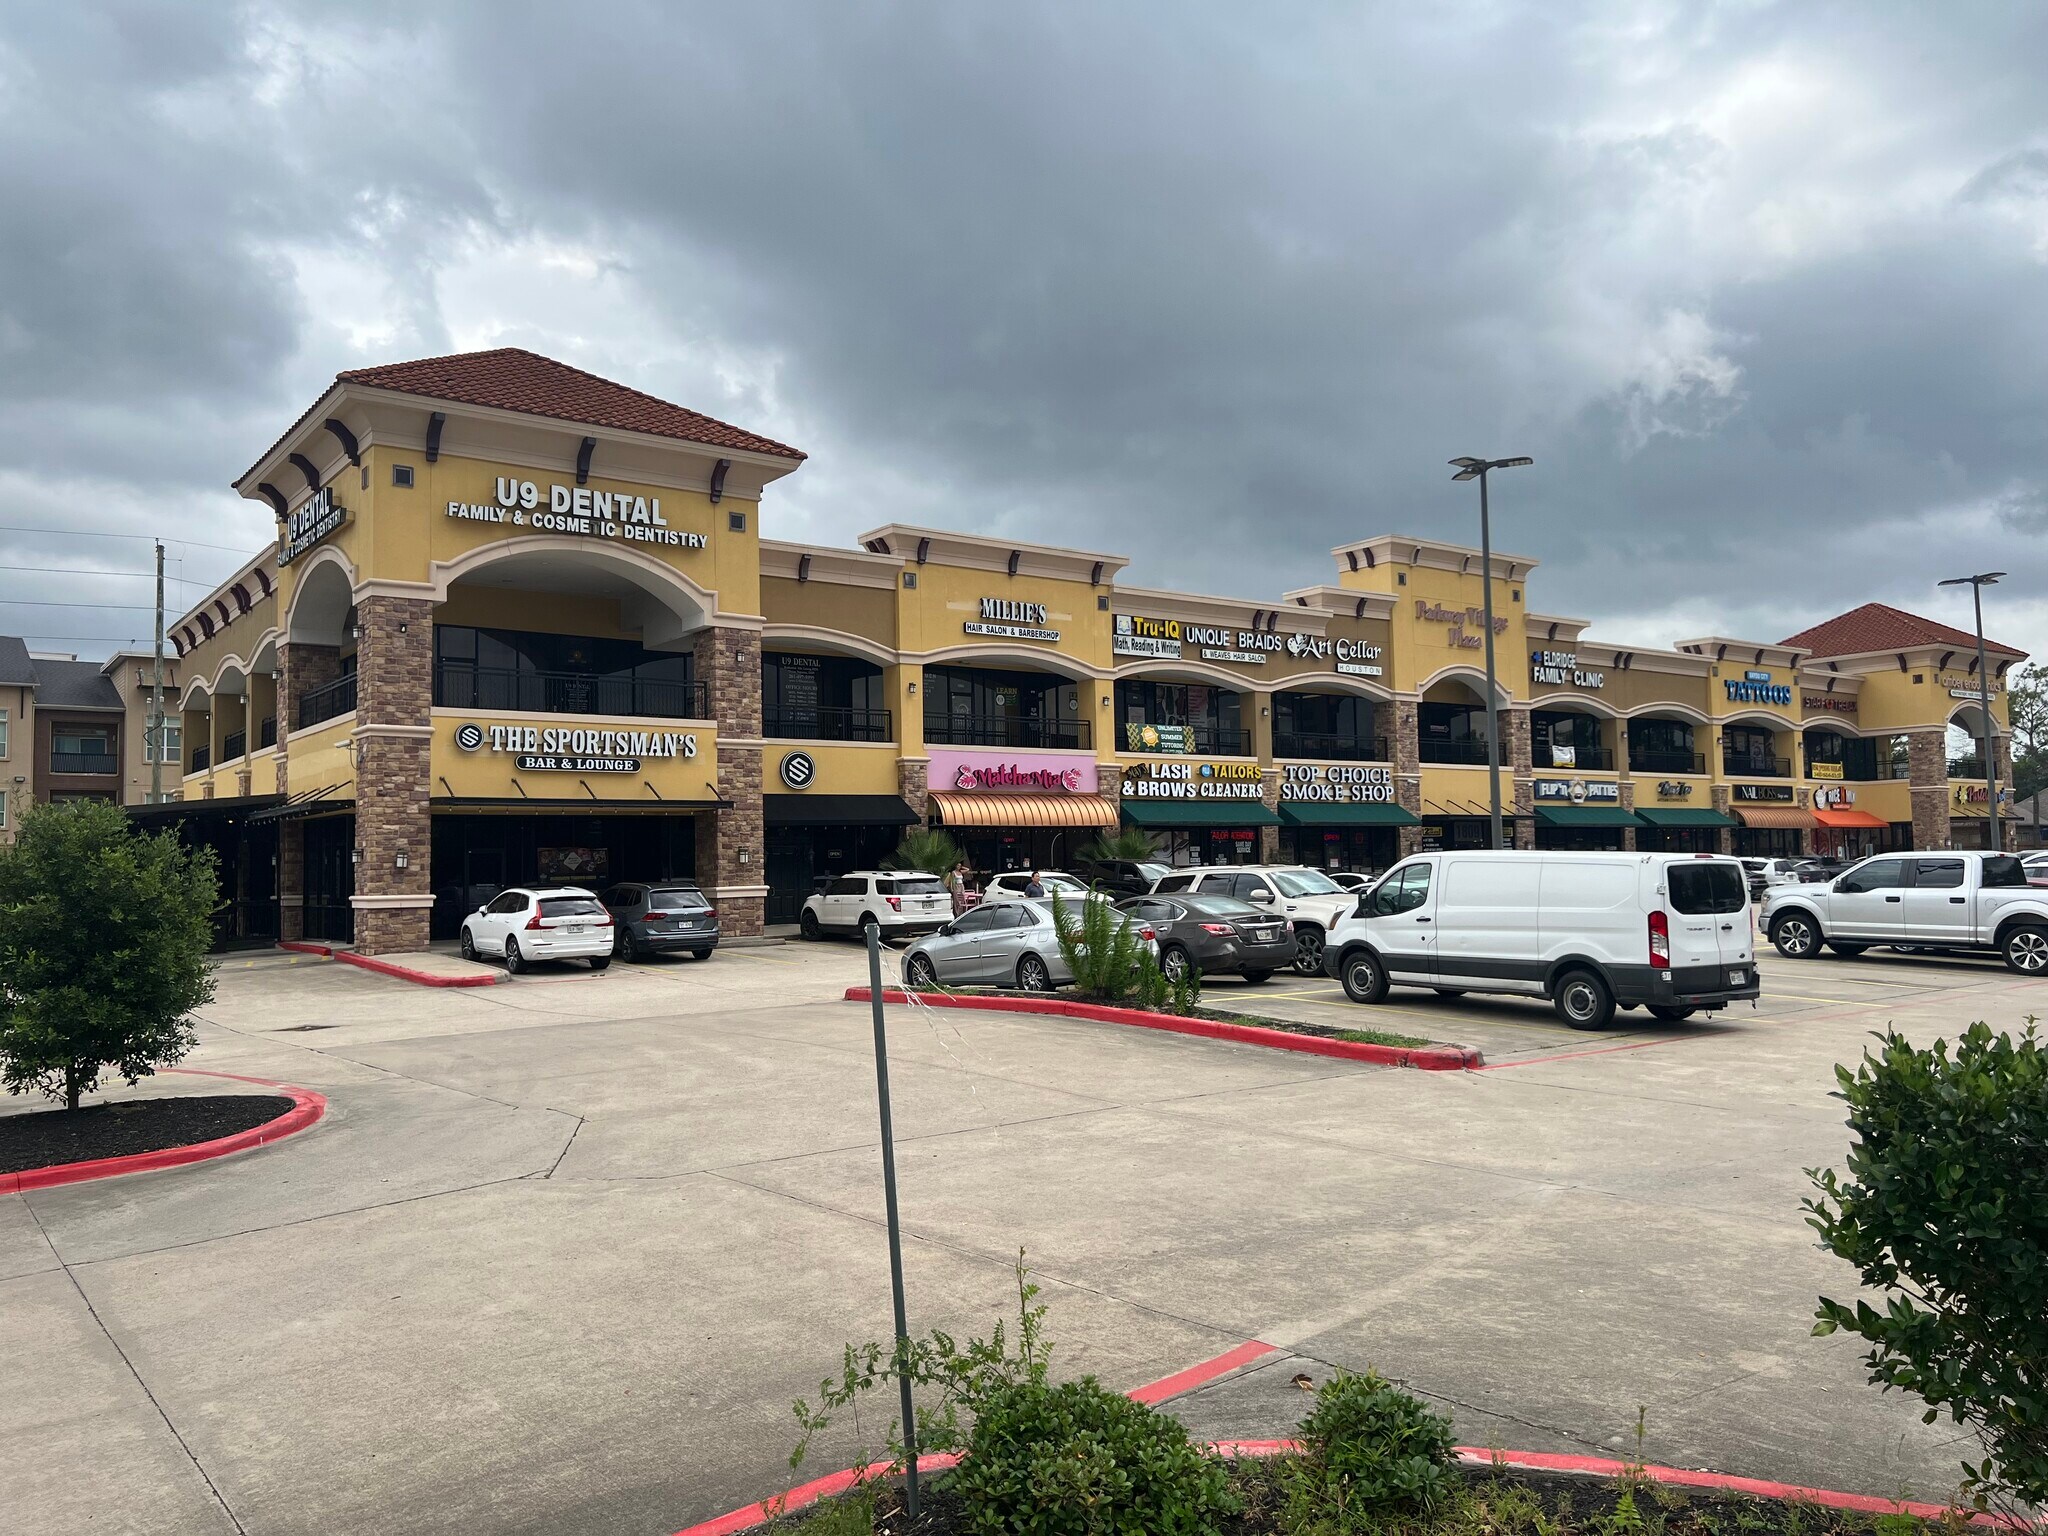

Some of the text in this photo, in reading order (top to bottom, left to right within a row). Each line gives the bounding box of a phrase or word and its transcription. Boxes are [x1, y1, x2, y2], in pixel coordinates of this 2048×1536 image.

[497, 477, 667, 526] U9 DENTAL
[287, 486, 330, 543] U9 DENTAL
[448, 502, 708, 549] FAMILY & COSMEIC DENTISTRY
[981, 597, 1047, 625] MILLIE'S
[1415, 600, 1466, 630] Parkway
[966, 623, 1059, 640] HAIR SALON & BARBERSHOP
[1133, 616, 1180, 640] Tru-IQ
[1131, 638, 1154, 655] Reading
[1155, 640, 1159, 653] &
[1160, 640, 1180, 658] Writing
[1186, 626, 1282, 651] UNIQUE BRAIDS
[1302, 634, 1382, 662] Art Cellar
[781, 656, 821, 667] U9 DENTAL
[1210, 650, 1231, 660] WEAVES
[1233, 653, 1246, 661] HAIR
[1247, 654, 1265, 662] SALON
[1543, 650, 1576, 669] ELDRIDGE
[1338, 664, 1381, 674] HOUSTON
[1534, 666, 1604, 688] FAMILY CLINIC
[996, 687, 1018, 695] LEARN
[1726, 680, 1791, 705] TATTOOS
[489, 725, 697, 758] THE SPORTSMAN'S
[525, 757, 633, 771] BAR & LOUNGE
[1150, 763, 1192, 779] LASH
[1212, 764, 1262, 779] TAILORS
[975, 763, 1062, 789] Matcha Mia
[1284, 765, 1391, 784] TOP CHOICE
[1121, 780, 1197, 798] & BROWS
[1200, 782, 1263, 798] CLEANERS
[1281, 783, 1394, 801] SMOKE SHOP
[1588, 784, 1619, 796] PATTIES
[1742, 786, 1758, 799] NAIL
[1758, 787, 1776, 799] BOSS
